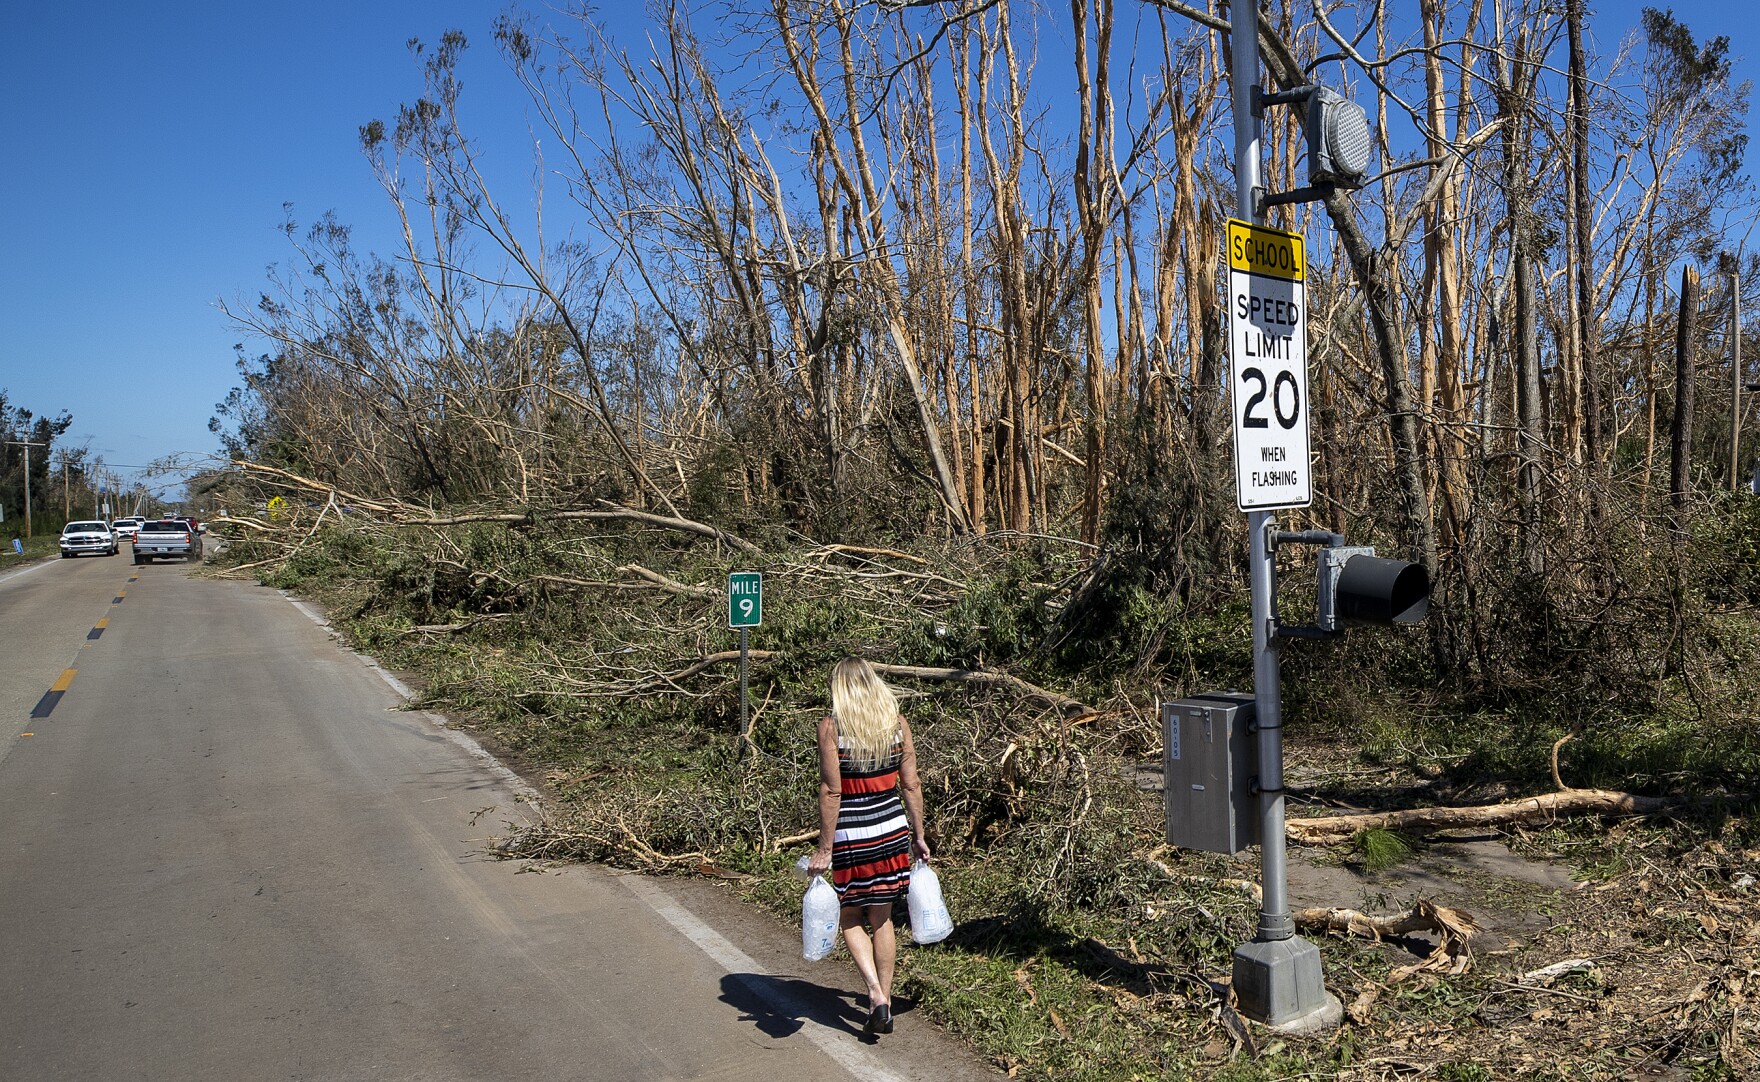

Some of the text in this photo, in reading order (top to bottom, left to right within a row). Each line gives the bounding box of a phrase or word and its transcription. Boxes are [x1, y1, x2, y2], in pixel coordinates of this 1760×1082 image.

[1234, 234, 1300, 273] SCHOOL
[1237, 294, 1299, 326] SPEED
[1245, 331, 1292, 360] LIMIT
[1241, 367, 1300, 430] 20
[1260, 446, 1286, 463] WHEN
[1252, 471, 1298, 487] FLASHING
[732, 581, 758, 594] MILE
[739, 598, 753, 617] 9
